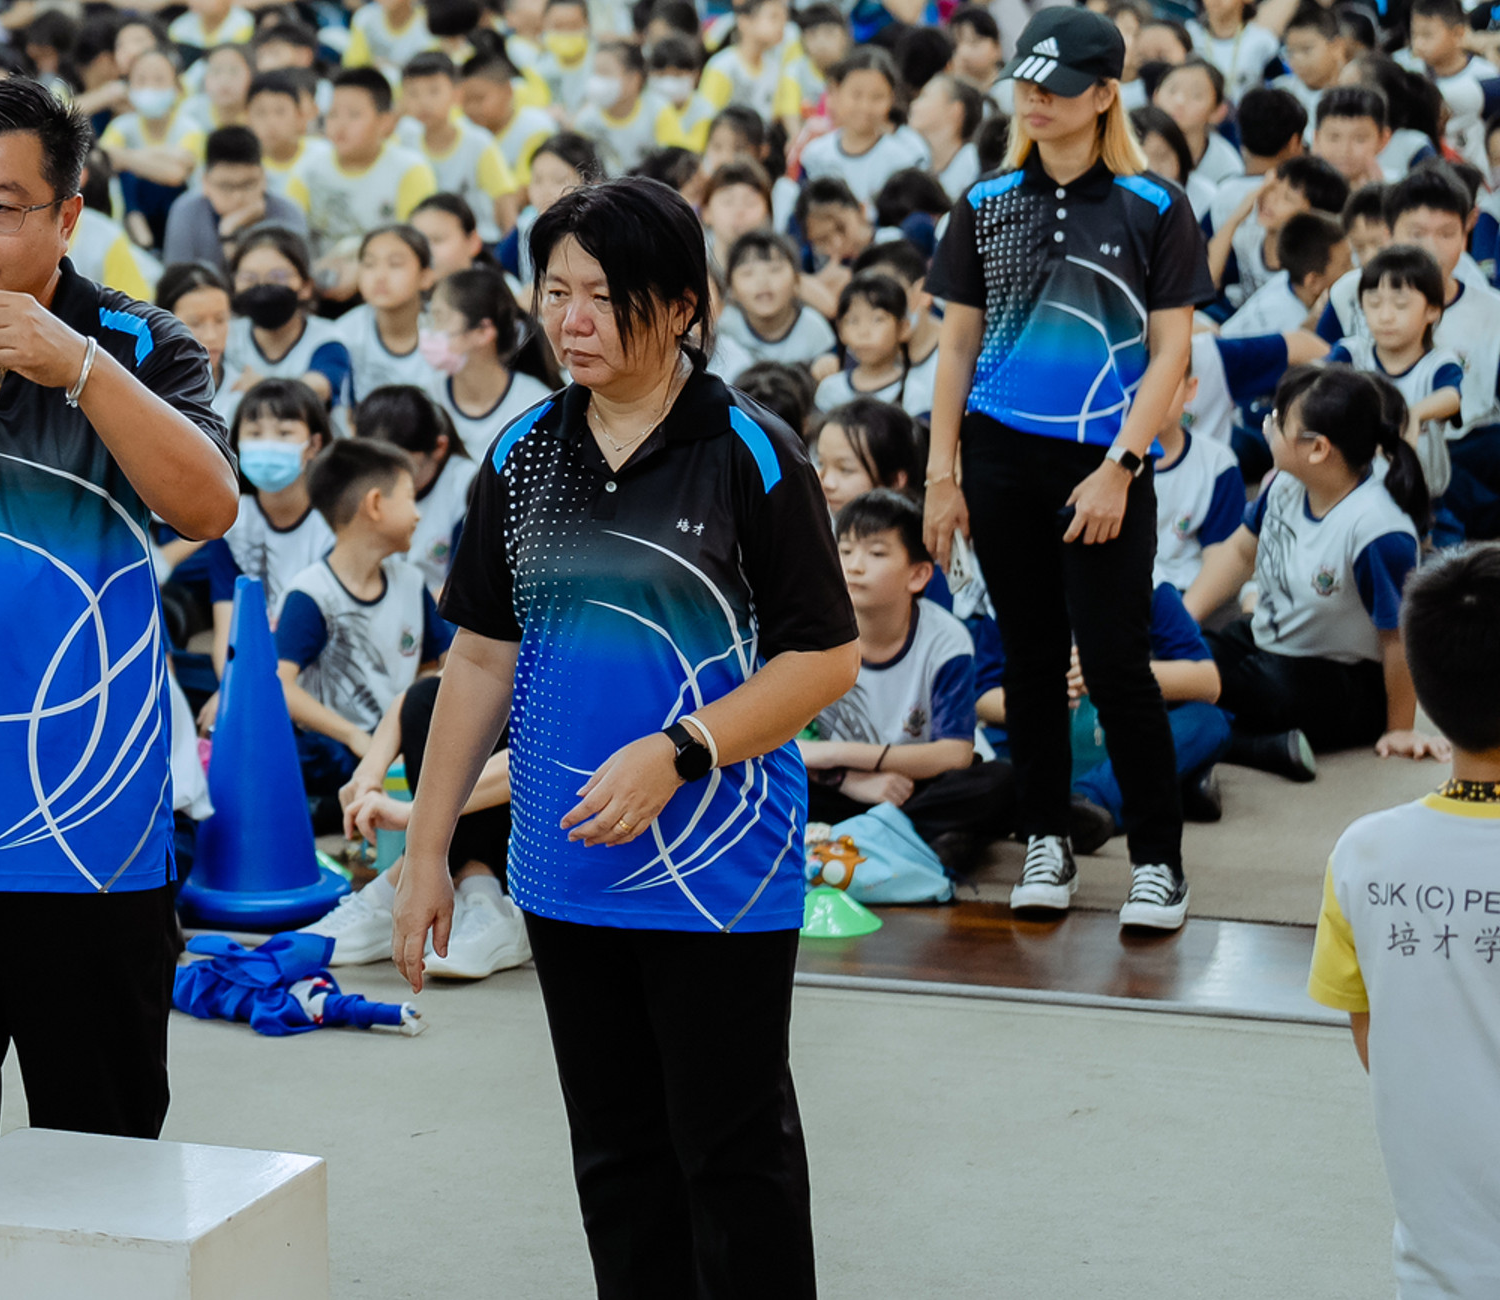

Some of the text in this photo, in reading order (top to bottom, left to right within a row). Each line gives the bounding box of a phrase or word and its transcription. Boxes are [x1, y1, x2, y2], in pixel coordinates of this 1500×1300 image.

[1367, 882, 1500, 915] SJK (C) PE
[1387, 921, 1500, 964] 培才学
